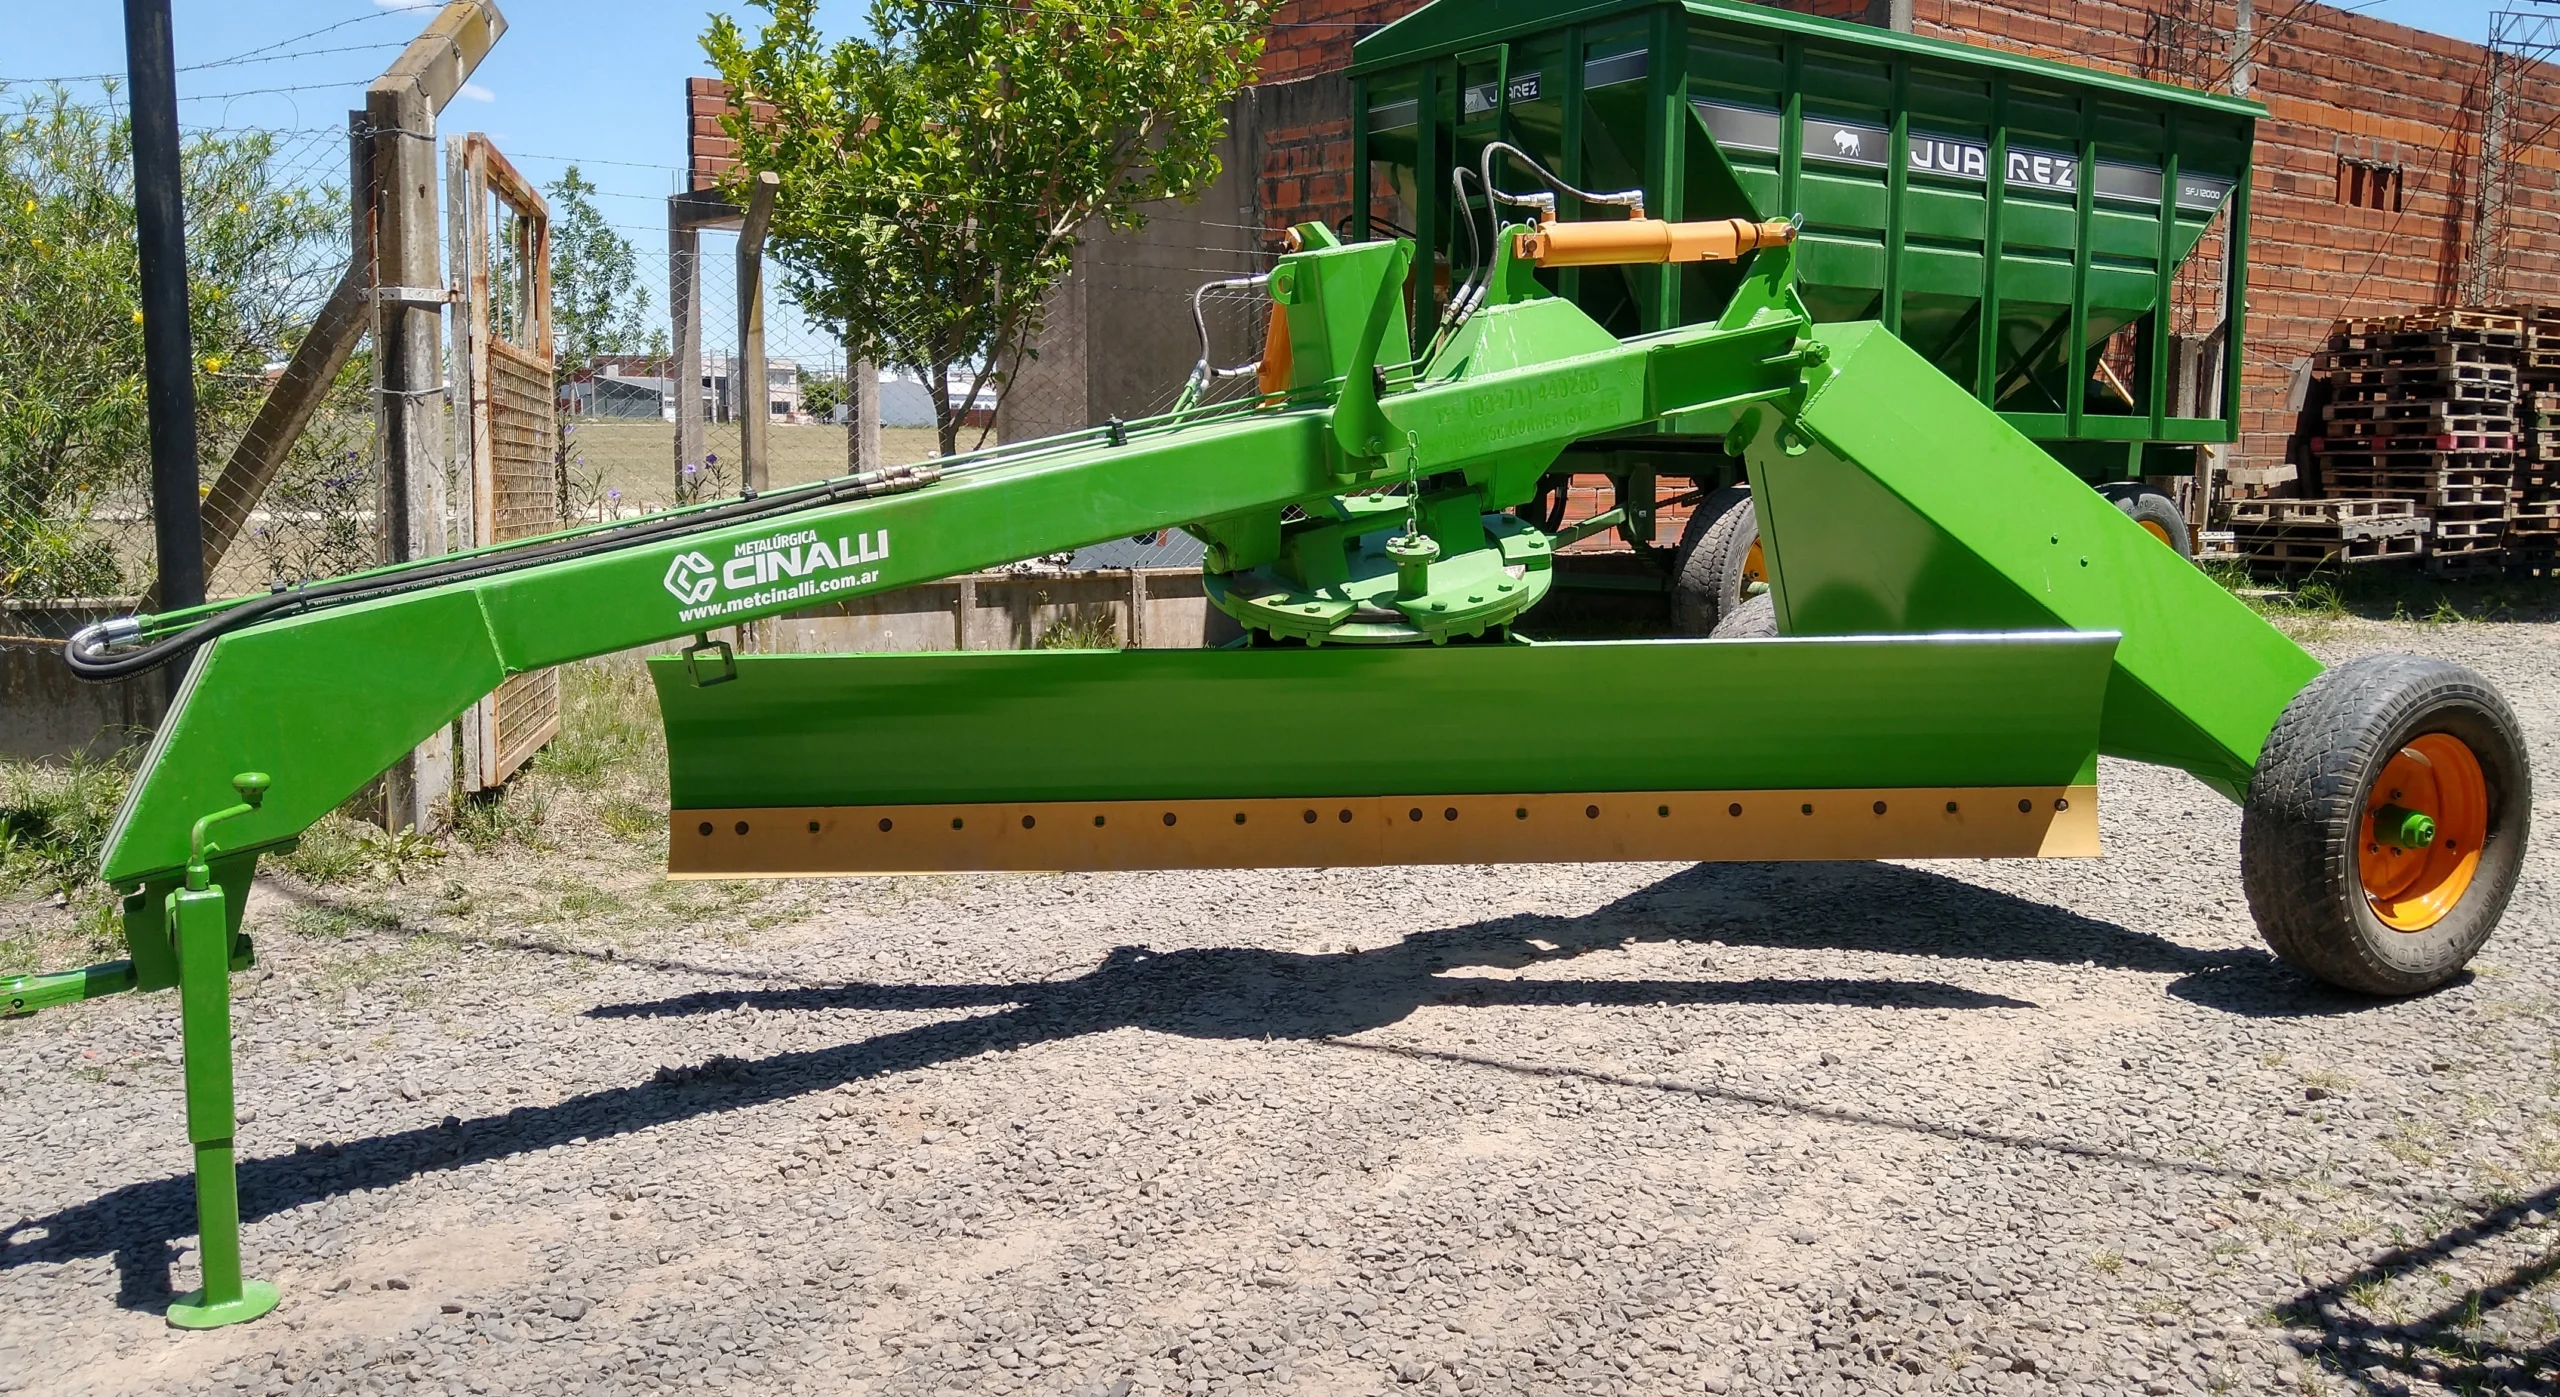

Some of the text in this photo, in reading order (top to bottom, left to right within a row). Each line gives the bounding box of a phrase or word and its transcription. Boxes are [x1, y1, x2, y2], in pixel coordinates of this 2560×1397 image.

[1489, 81, 1538, 102] JAREZ
[1910, 140, 2073, 187] JUAREZ
[2185, 187, 2220, 200] SFJ 12000
[722, 529, 890, 590] CINALLI
[734, 529, 817, 557] METALÚRGICA
[678, 569, 879, 622] www.metcinalli.com.ar
